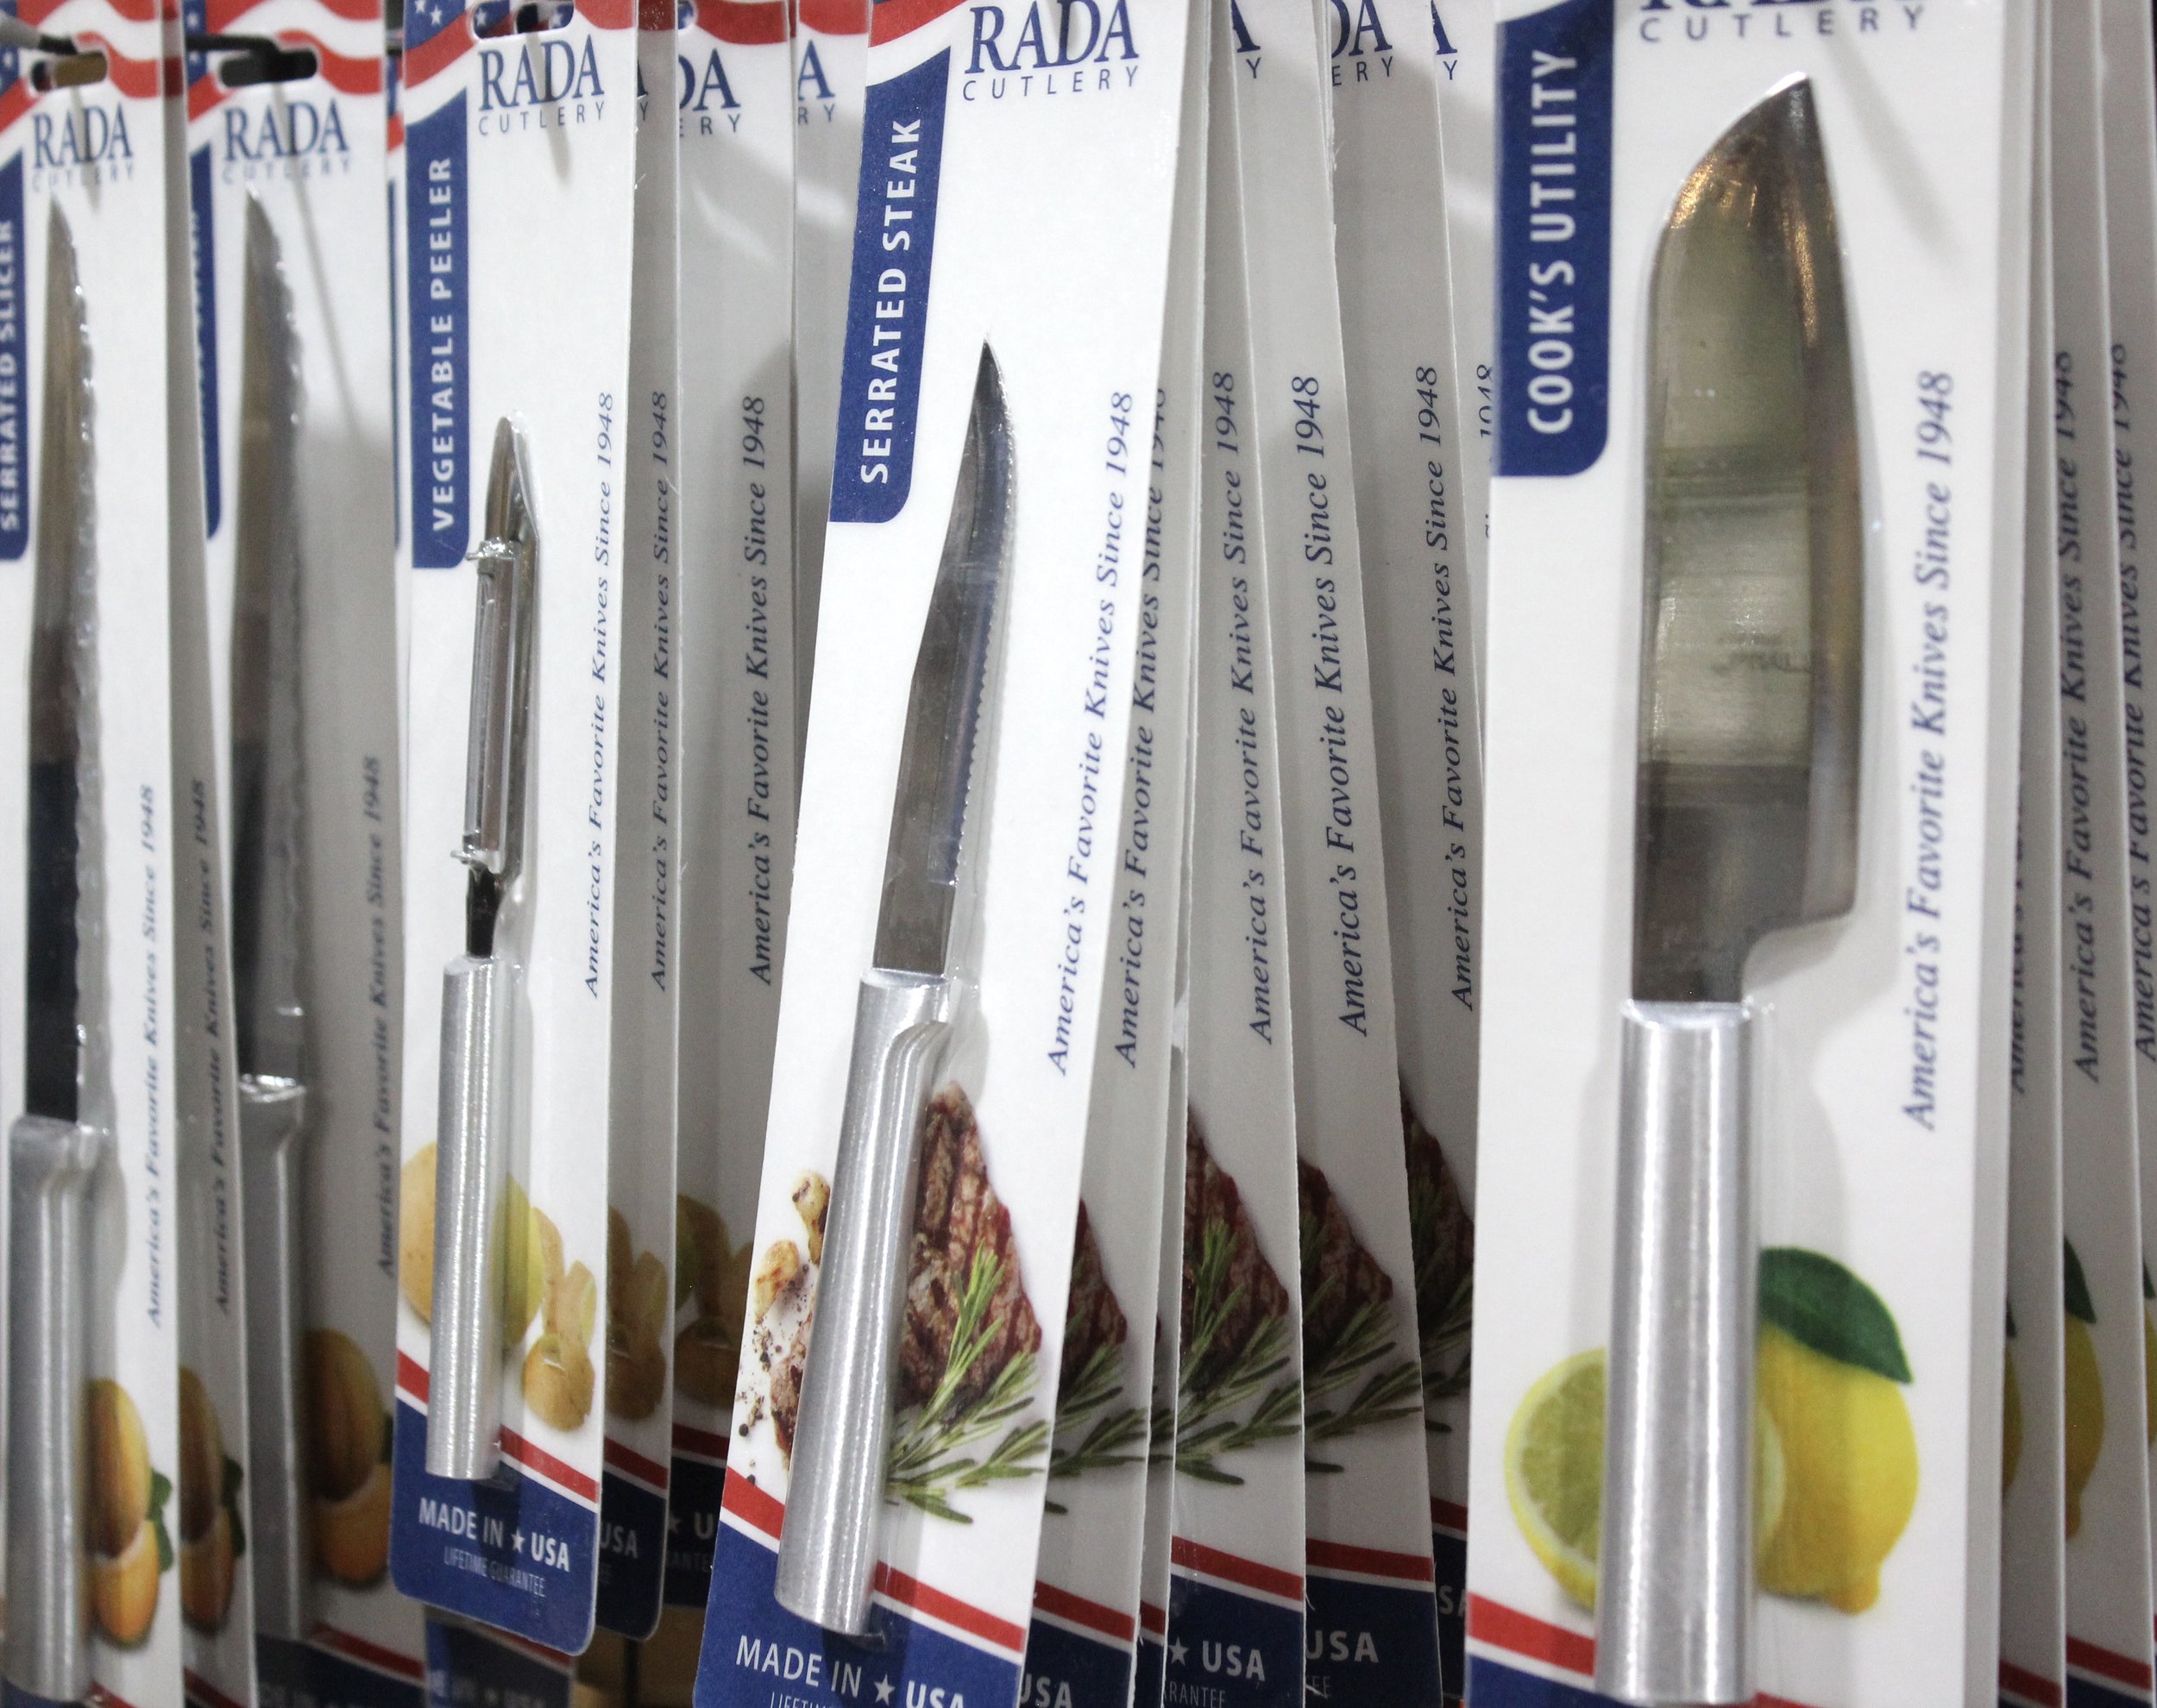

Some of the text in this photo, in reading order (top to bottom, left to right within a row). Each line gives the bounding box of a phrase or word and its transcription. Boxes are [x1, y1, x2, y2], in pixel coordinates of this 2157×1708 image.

[478, 35, 603, 113] RADA
[963, 66, 1138, 101] CUTLERY
[965, 0, 1139, 73] RADA
[1640, 5, 1924, 42] CUTLERY
[31, 162, 134, 192] CUTLERY
[32, 103, 133, 169] RADA
[223, 155, 352, 184] CUTLERY
[225, 98, 350, 160] RADA
[479, 103, 604, 135] CUTLERY
[861, 118, 921, 484] SERRATED STEAK
[1527, 50, 1576, 434] COOK'S UTILITY
[0, 220, 19, 532] SERRATED SLICER
[430, 158, 454, 531] VEGETABLE PEELER
[584, 392, 613, 999] America's Favorite Knives Since 1948
[651, 392, 669, 992] America's Favorite Knives Since 1948
[742, 395, 770, 985] America's Favorite Knives Since 1948
[1133, 593, 1159, 713] Knives
[1212, 371, 1271, 1046] America's Favorite Knives Since 1948
[1292, 375, 1367, 1037] America's Favorite Knives Since 1948
[1415, 366, 1473, 1011] America's Favorite Knives Since 1948
[1047, 392, 1133, 1077] America's Favorite Knives Since 1948
[1125, 725, 1154, 879] Favorite
[1902, 370, 1954, 1132] America's Favorite Knives Since 1948
[1115, 889, 1146, 1069] America's
[2069, 892, 2099, 1084] America's
[418, 1498, 569, 1573] MADE IN USA
[443, 1547, 488, 1578] LIFETIME
[736, 1635, 822, 1687] MADE
[831, 1661, 862, 1699] IN
[1165, 1681, 1226, 1708] RANTEE
[1202, 1640, 1266, 1681] USA
